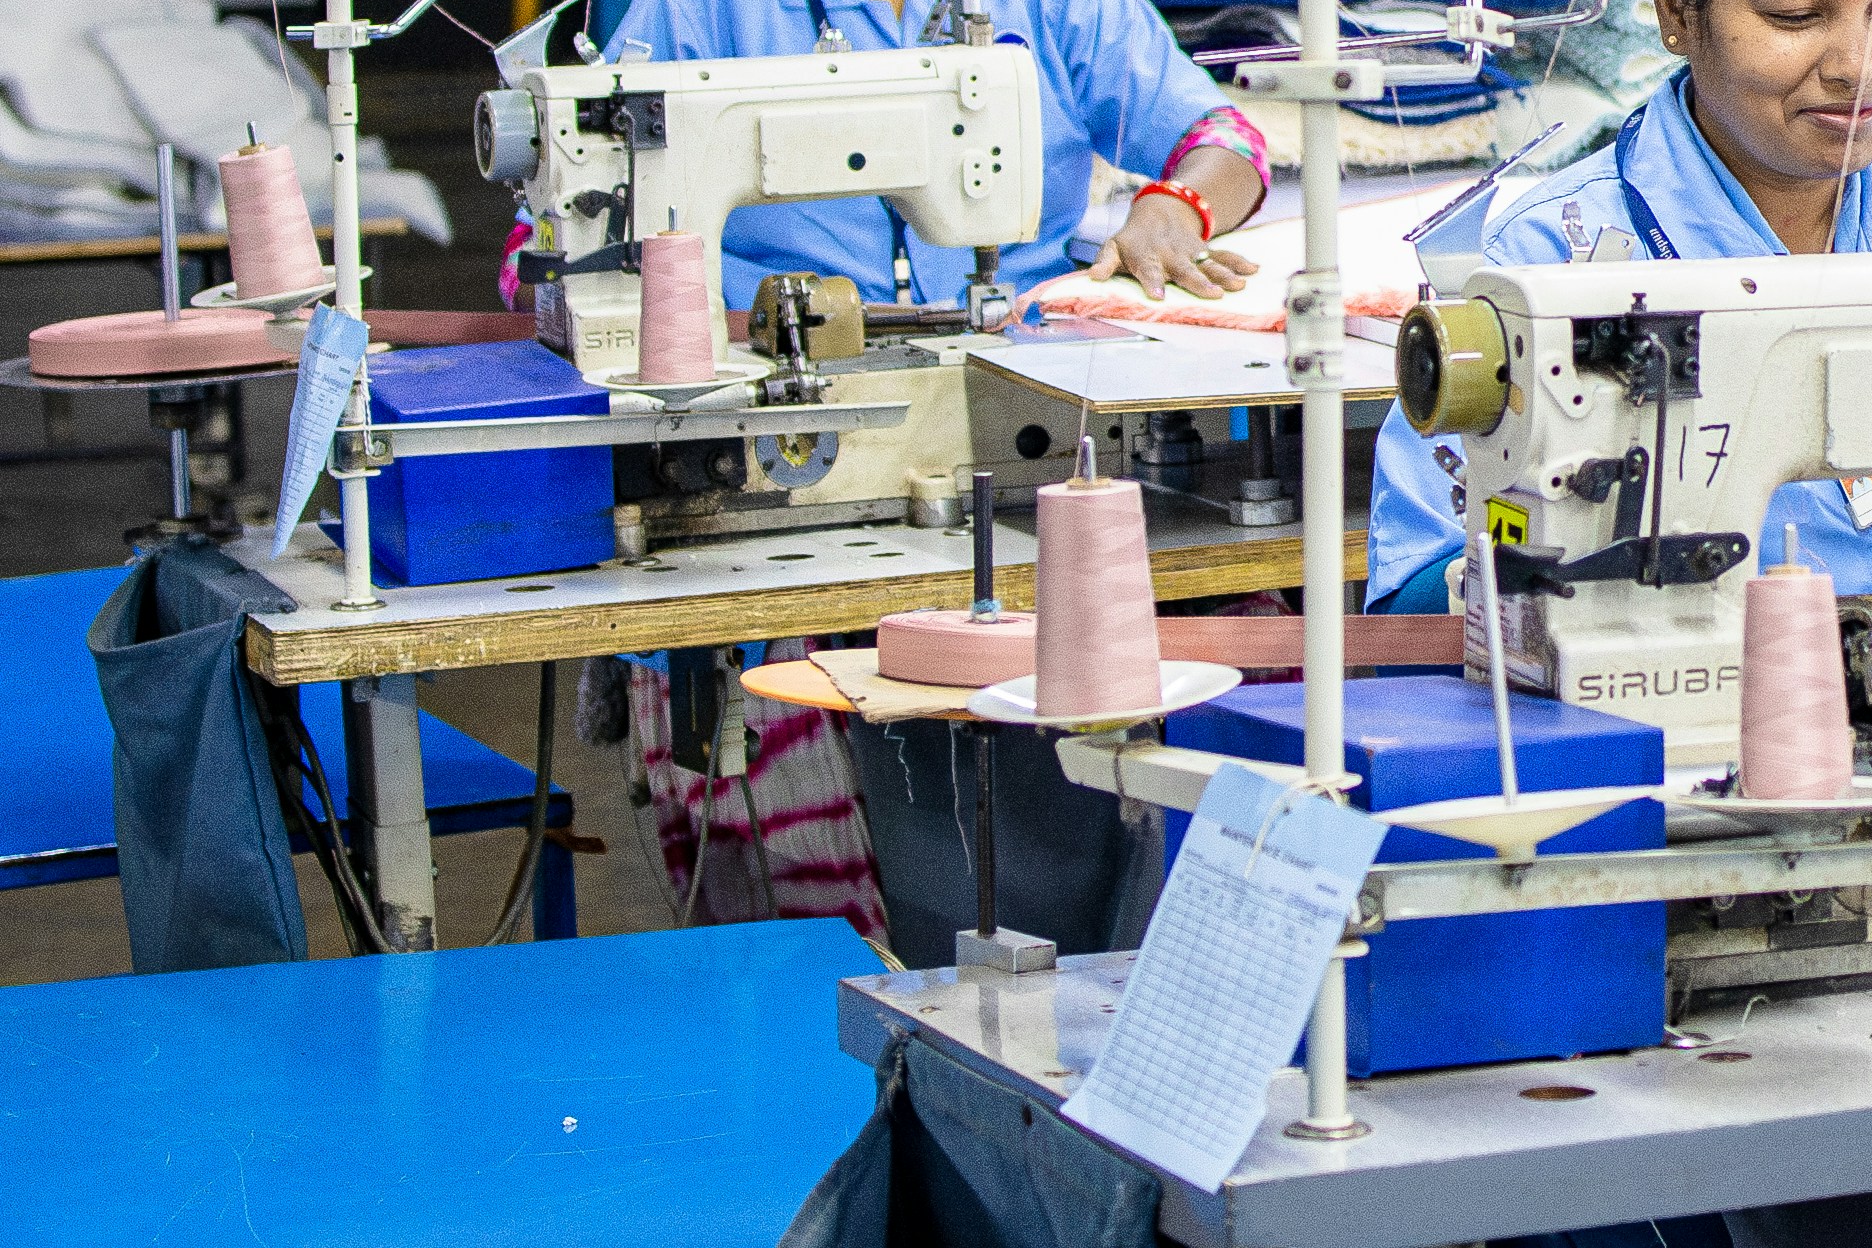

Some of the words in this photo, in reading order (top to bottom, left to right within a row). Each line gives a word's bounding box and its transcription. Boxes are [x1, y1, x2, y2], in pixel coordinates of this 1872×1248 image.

[1649, 227, 1673, 260] elspun
[584, 329, 634, 349] SiR
[1679, 423, 1730, 488] 17
